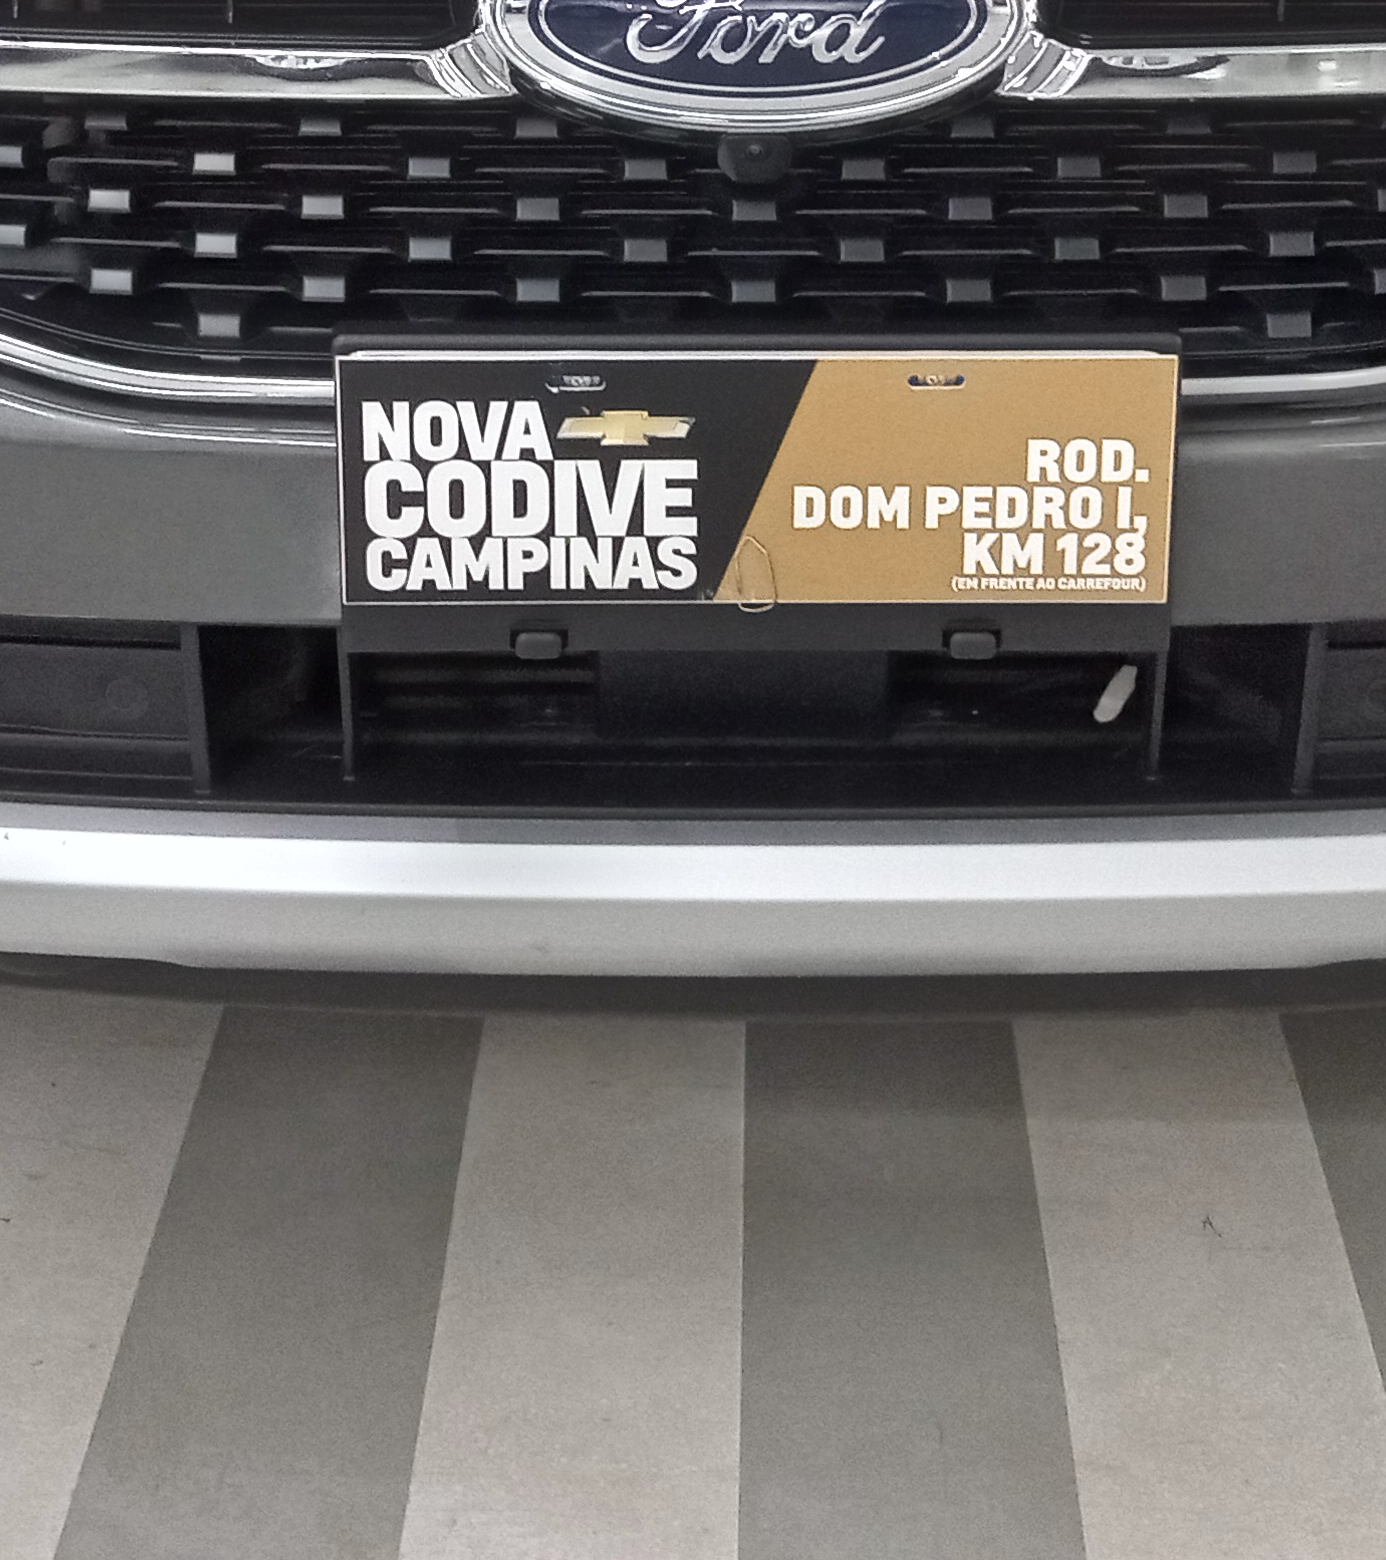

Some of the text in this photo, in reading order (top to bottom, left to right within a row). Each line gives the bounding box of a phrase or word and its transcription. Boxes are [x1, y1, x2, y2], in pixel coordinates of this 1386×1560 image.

[361, 400, 554, 461] NOVA
[1026, 438, 1150, 483] ROD.
[364, 459, 699, 538] CODIVE
[792, 485, 911, 530] DOM
[924, 485, 1103, 530] PEDRO
[365, 536, 699, 591] CAMPINAS
[963, 532, 1147, 576] KM 128
[951, 576, 1147, 591] (EM FRENTE AO CARREFOUR)
